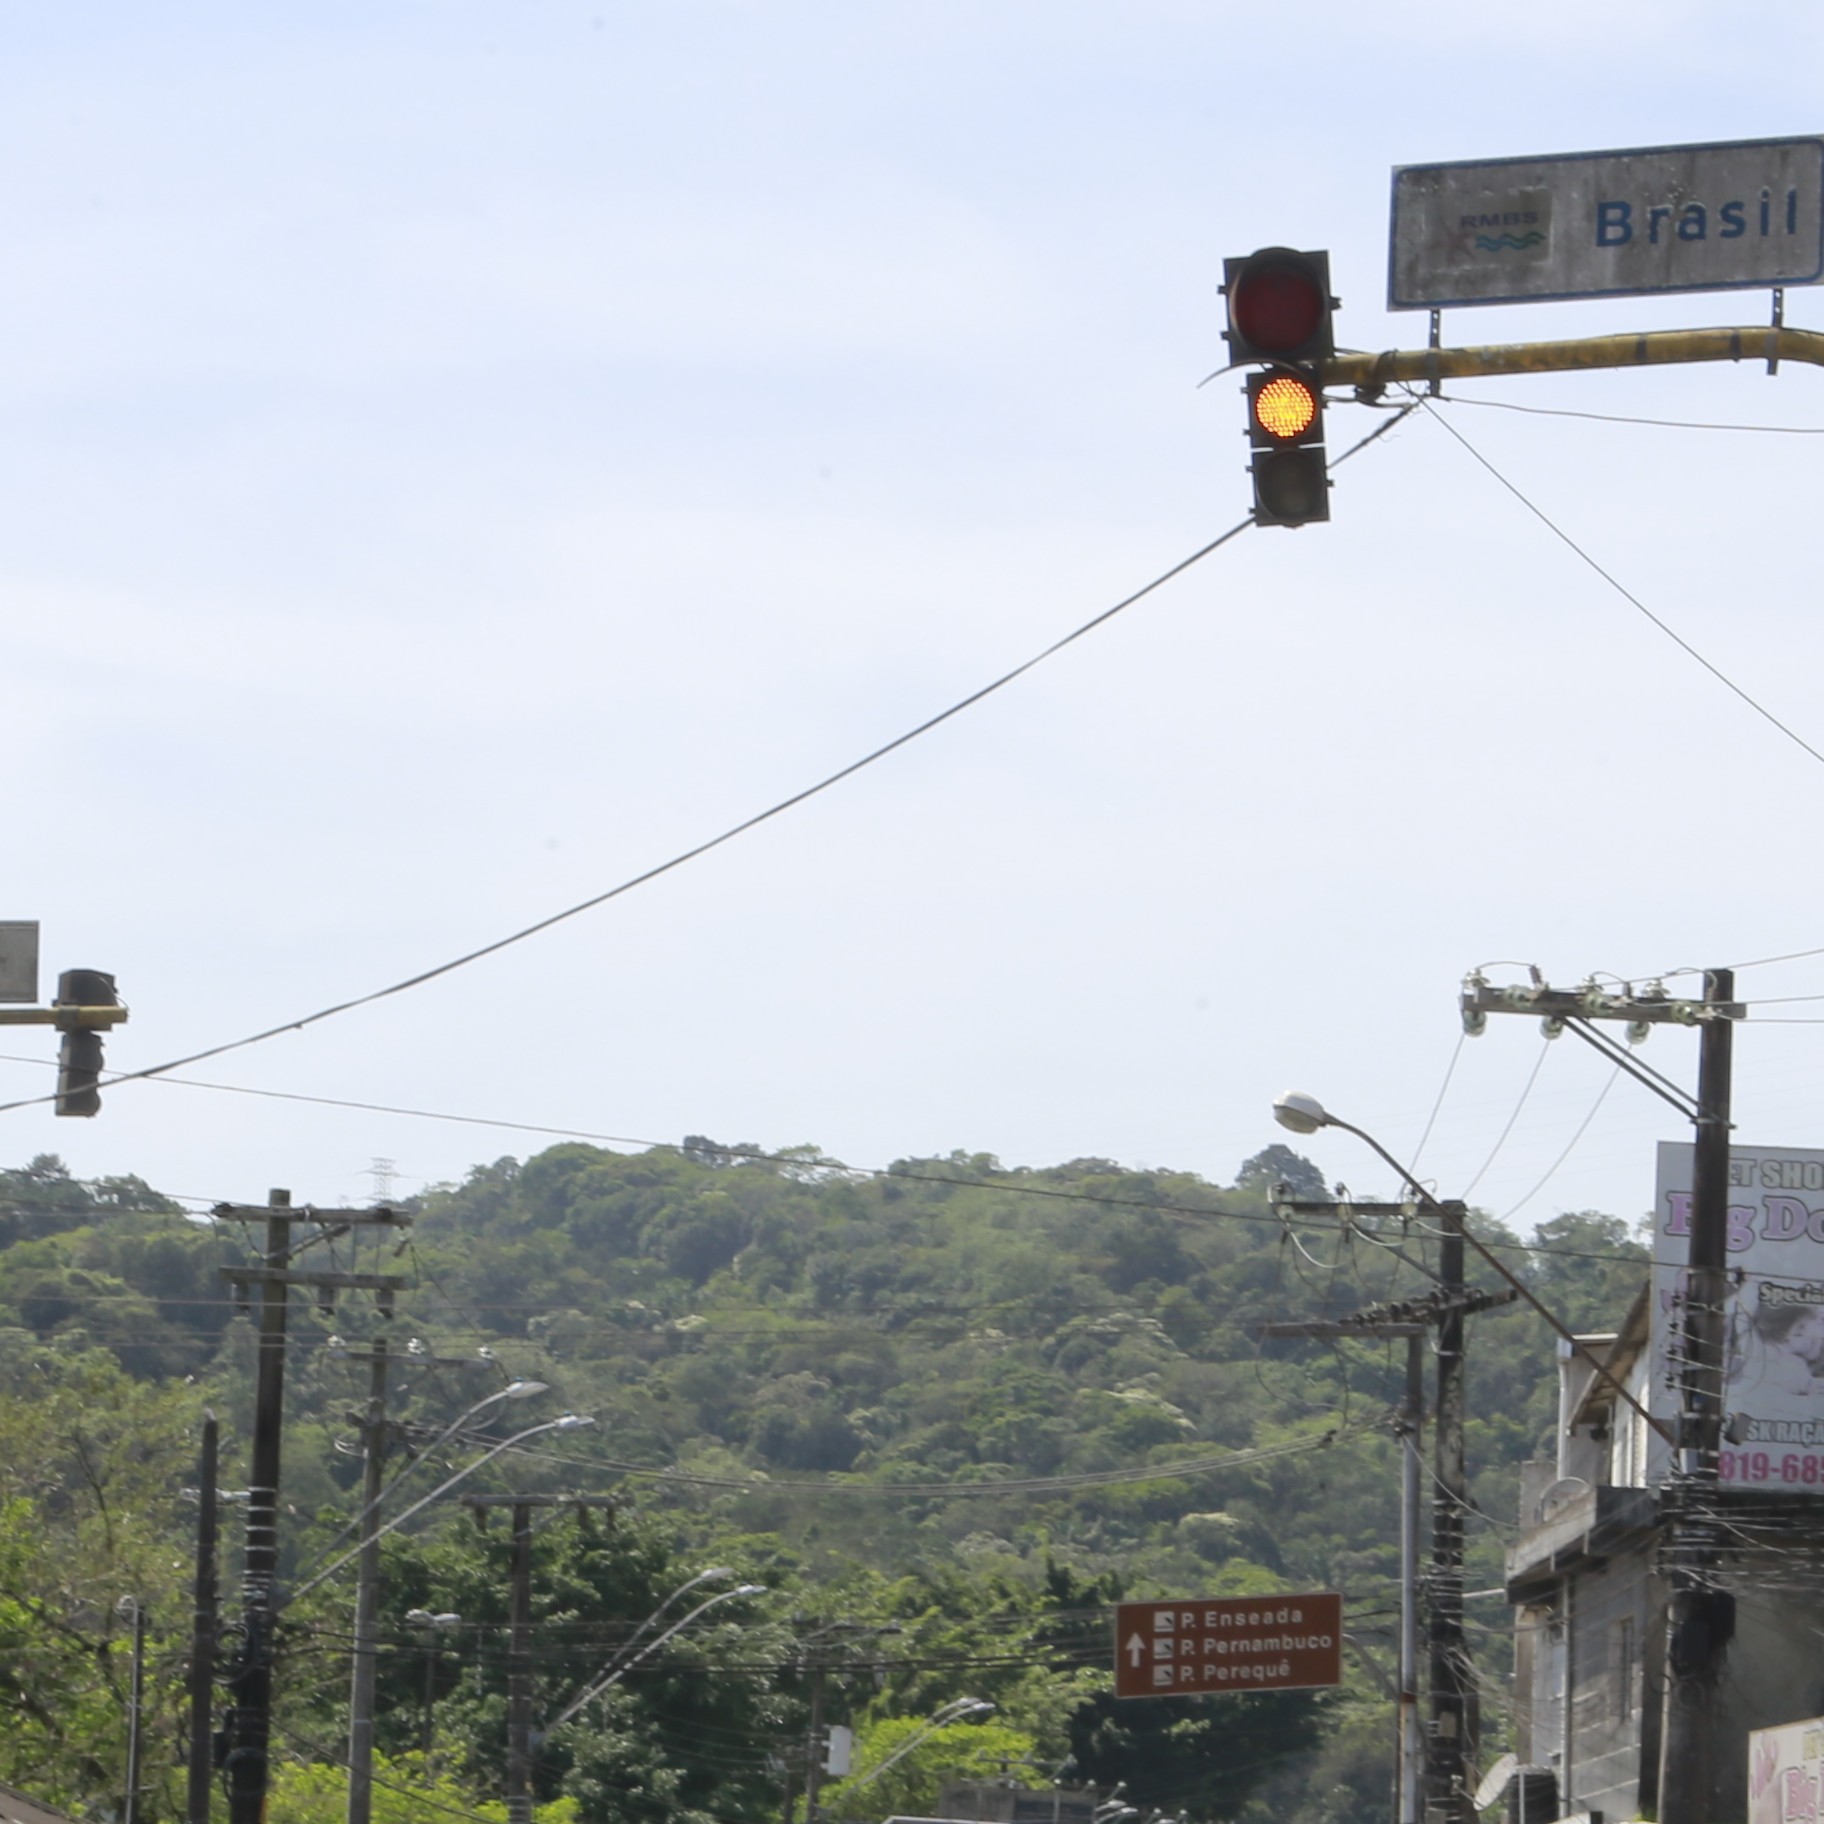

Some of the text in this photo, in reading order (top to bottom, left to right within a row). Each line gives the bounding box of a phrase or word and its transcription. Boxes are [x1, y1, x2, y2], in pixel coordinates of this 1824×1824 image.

[1458, 211, 1539, 230] RMBS
[1595, 184, 1798, 248] Brasil
[1728, 1158, 1758, 1188] ET
[1180, 1608, 1303, 1630] P. Enseada
[1180, 1634, 1333, 1656] P. Pernambuco
[1179, 1659, 1292, 1682] P. Perequê
